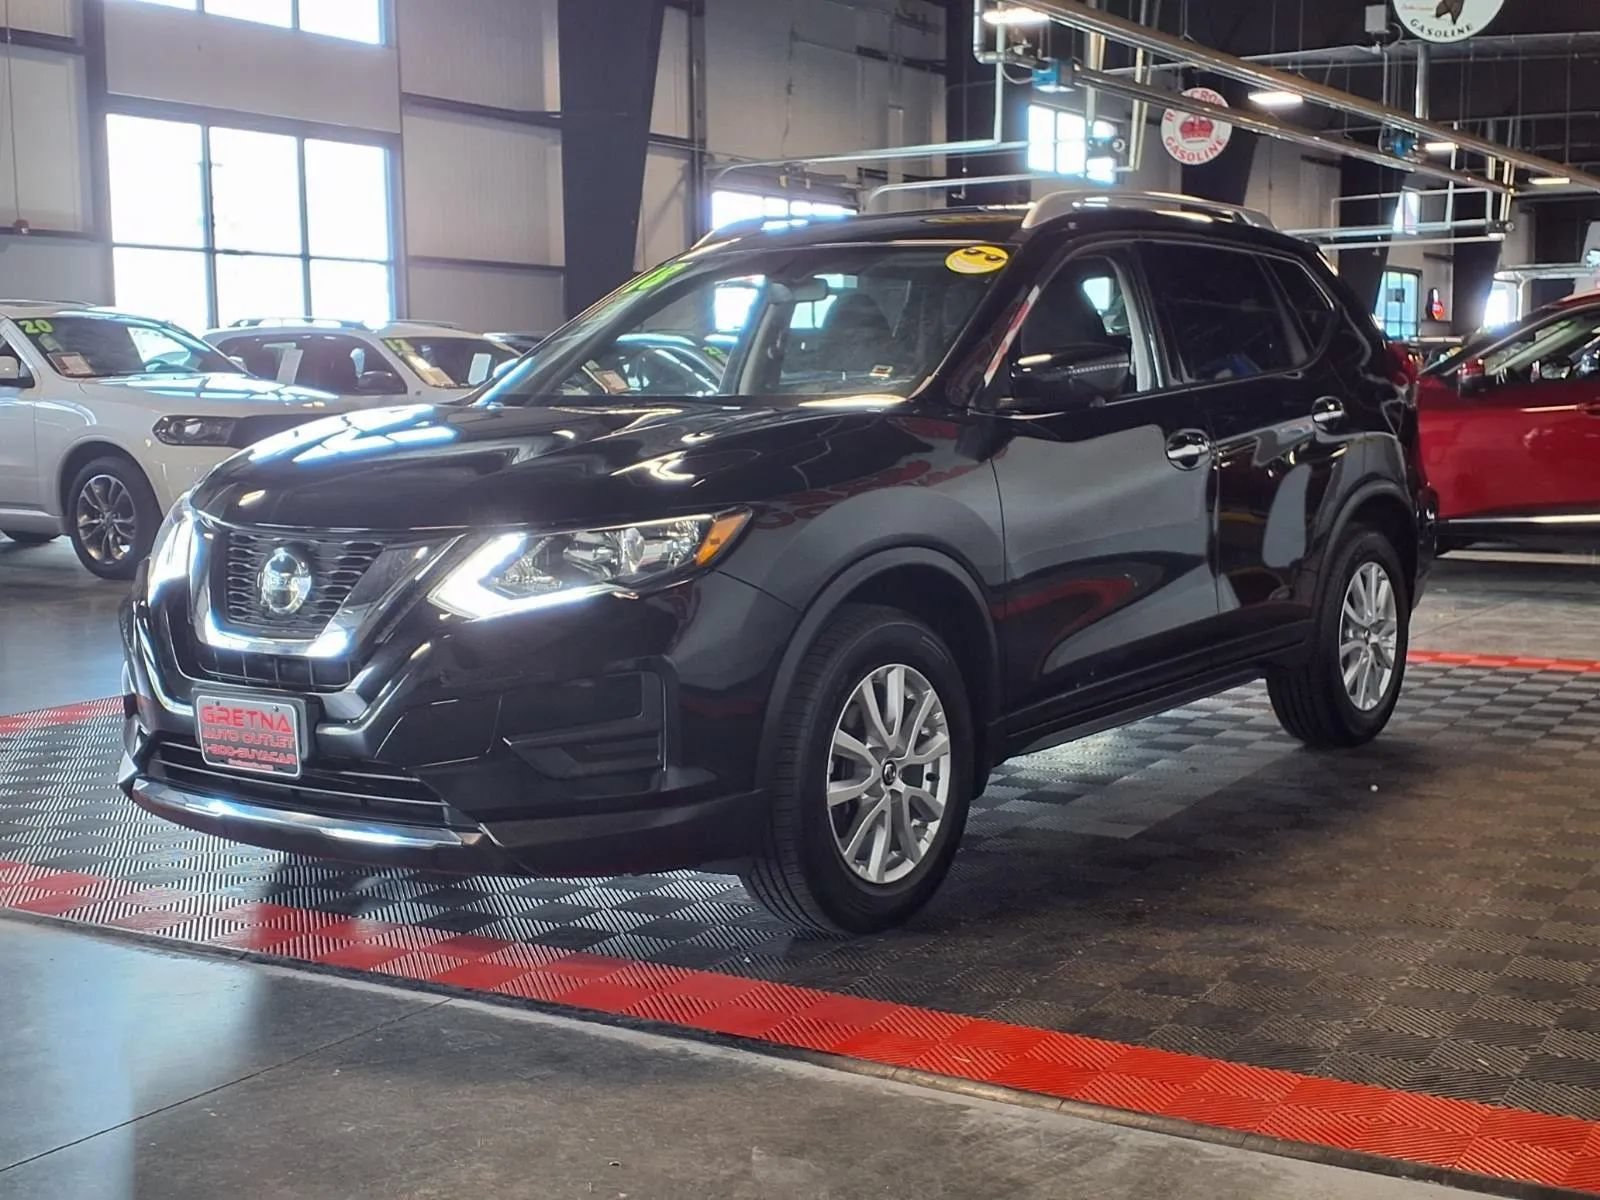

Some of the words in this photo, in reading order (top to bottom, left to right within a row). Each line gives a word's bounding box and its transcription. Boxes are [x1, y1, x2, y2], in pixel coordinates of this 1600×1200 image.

[1410, 18, 1473, 38] GASOLINE
[1165, 136, 1225, 162] GASOLINE
[17, 319, 54, 334] 20
[202, 705, 293, 734] GRETNA
